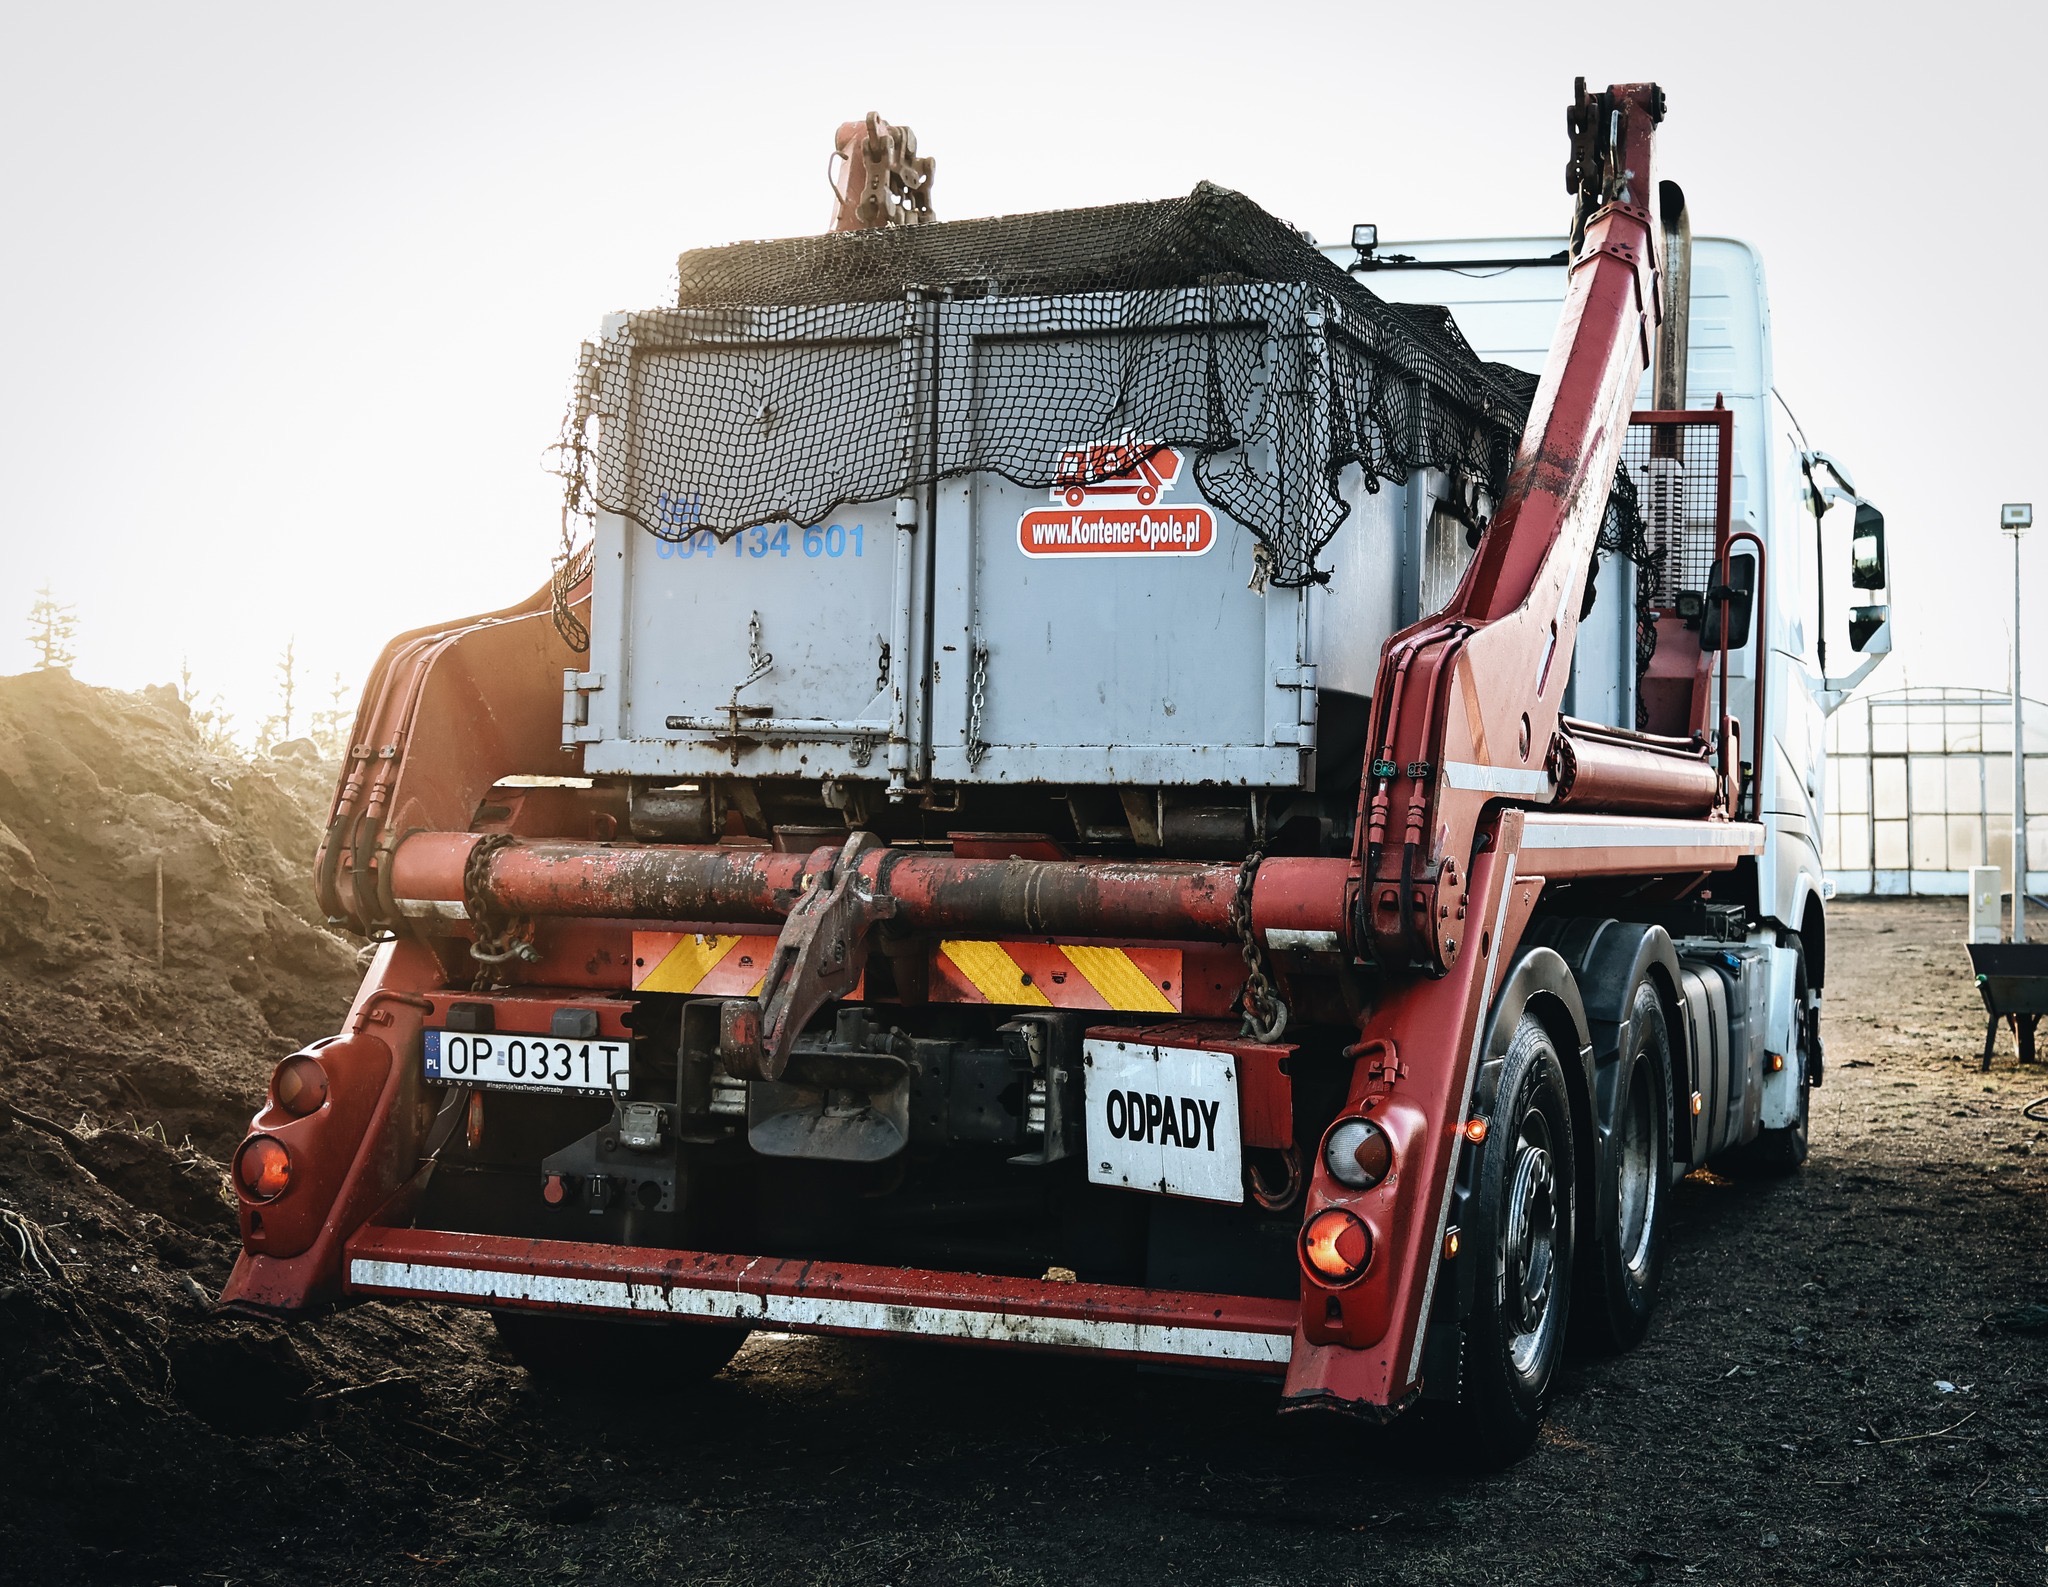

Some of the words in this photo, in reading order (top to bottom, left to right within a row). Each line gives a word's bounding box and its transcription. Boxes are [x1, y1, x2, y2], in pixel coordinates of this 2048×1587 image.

[733, 525, 790, 557] 134
[803, 524, 864, 557] 601
[1032, 514, 1200, 550] www.Kontener-Opole.pl
[426, 1059, 439, 1070] PL
[448, 1037, 492, 1075] OP
[508, 1040, 619, 1084] 0331T
[426, 1078, 473, 1087] VOLVO
[1106, 1089, 1220, 1152] ODPADY
